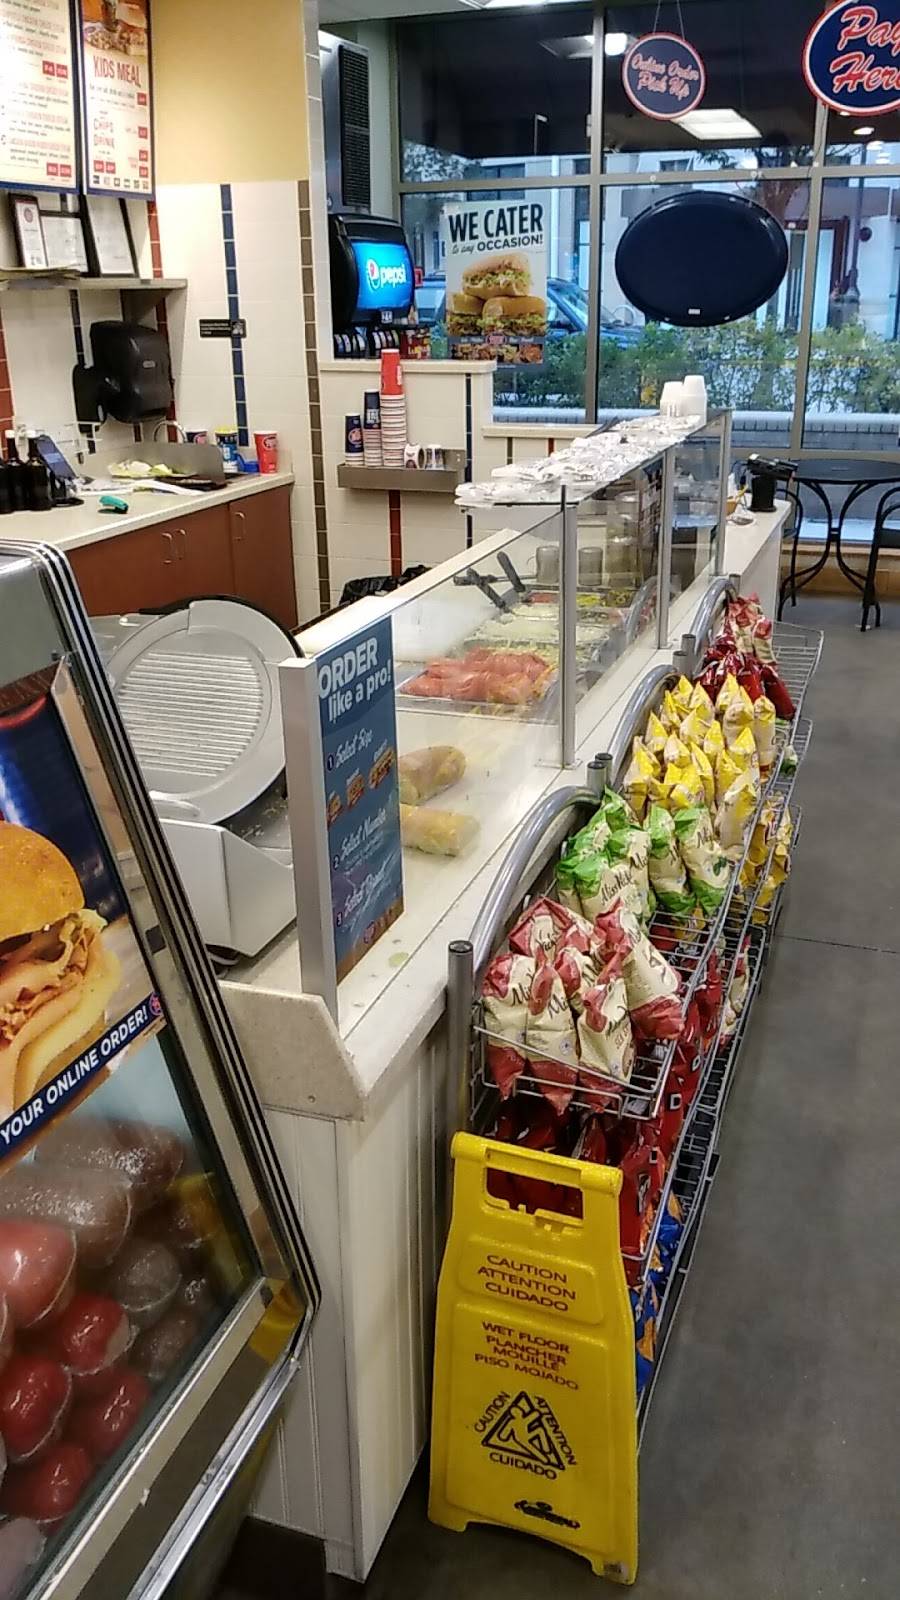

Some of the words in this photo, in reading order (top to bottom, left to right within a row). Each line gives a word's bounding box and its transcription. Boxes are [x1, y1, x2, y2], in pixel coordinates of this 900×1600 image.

[93, 56, 115, 80] KIDS
[116, 62, 142, 88] MEAL
[632, 53, 666, 75] Online
[668, 60, 699, 80] Order
[830, 51, 900, 93] Her
[637, 71, 668, 93] Pick
[669, 77, 690, 101] Up
[448, 211, 479, 243] WE
[484, 203, 543, 238] CATER
[477, 234, 543, 251] OCCASION!
[380, 262, 407, 288] pepsi
[319, 637, 378, 699] ORDER
[328, 689, 353, 724] like
[355, 682, 364, 703] a
[366, 659, 391, 700] pro!
[0, 1098, 44, 1145] YOUR
[46, 1048, 100, 1104] ONLINE
[100, 1005, 149, 1056] ORDER!
[478, 1266, 576, 1300] ATTENTION
[487, 1255, 567, 1283] CAUTION
[485, 1282, 569, 1311] CUIDADO
[482, 1321, 515, 1337] WET
[519, 1331, 570, 1353] FLOOR
[486, 1335, 566, 1365] PLANCHER
[474, 1353, 509, 1368] PISO
[514, 1363, 579, 1390] MOJADO
[474, 1391, 511, 1433] CAUTION
[534, 1395, 577, 1466] ATTENTION
[490, 1452, 557, 1480] CUIDADO
